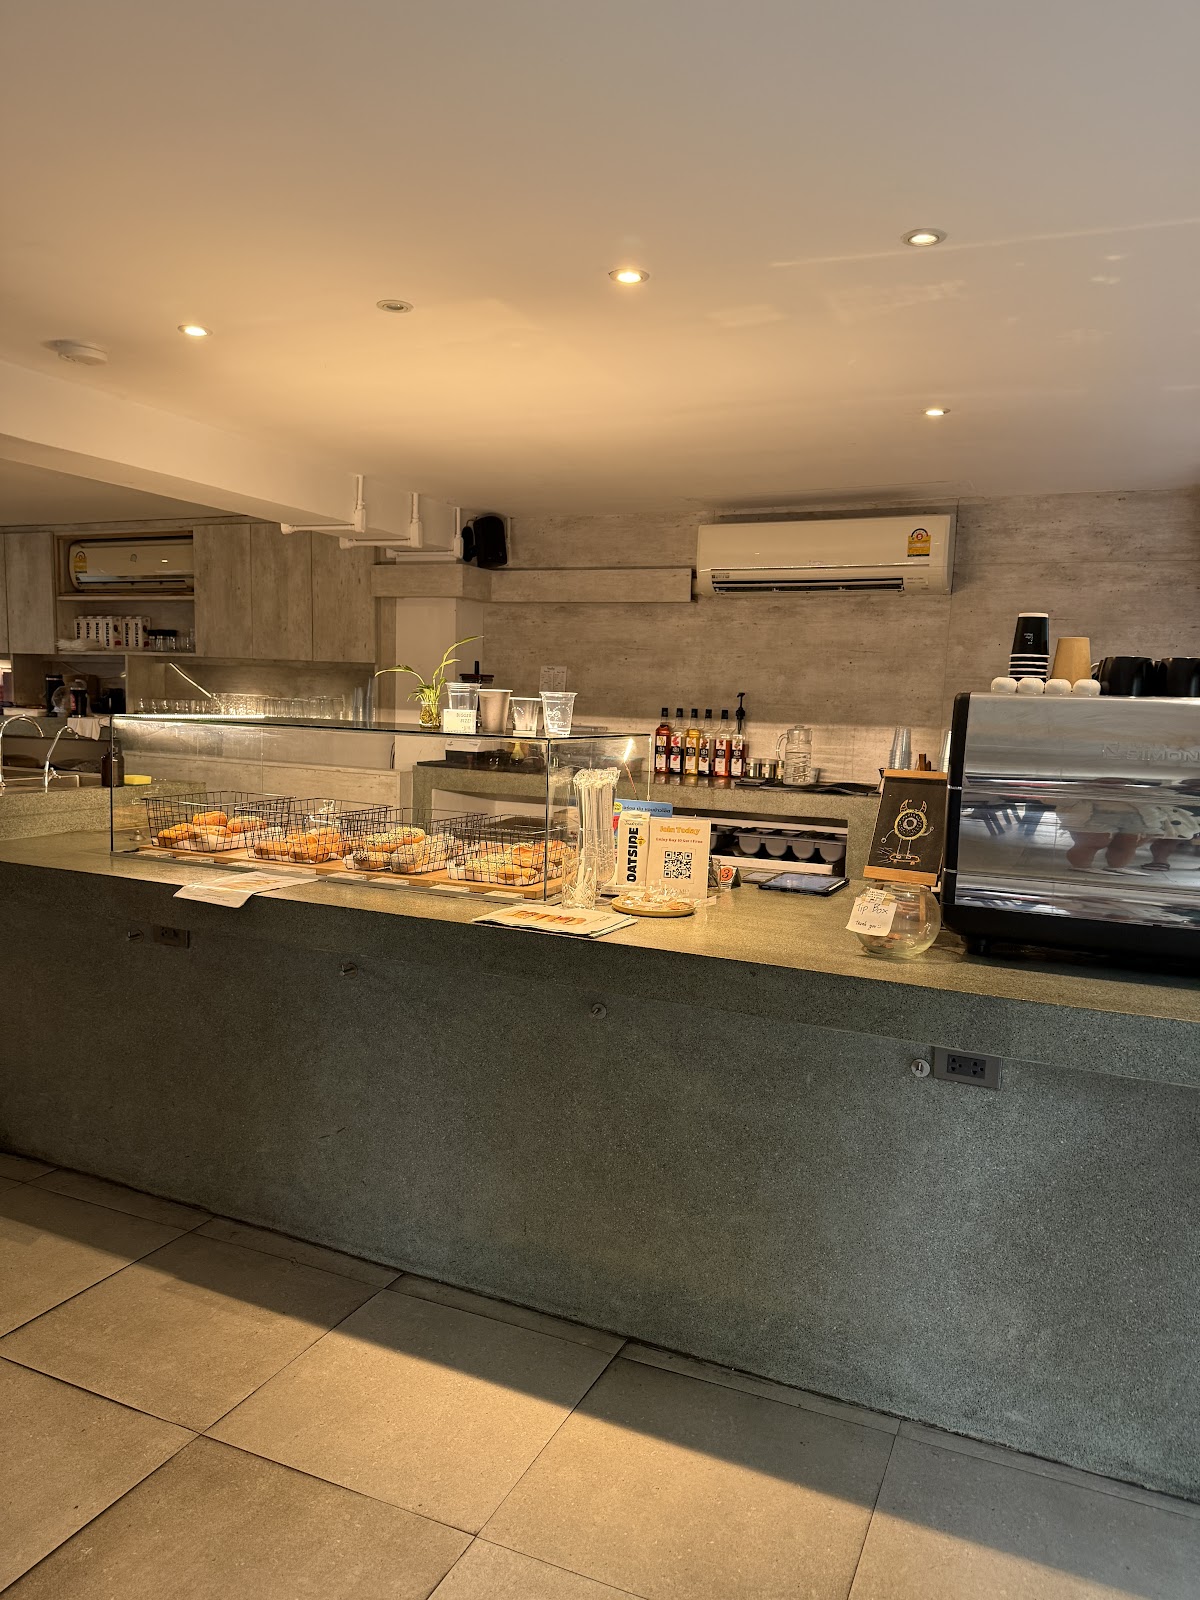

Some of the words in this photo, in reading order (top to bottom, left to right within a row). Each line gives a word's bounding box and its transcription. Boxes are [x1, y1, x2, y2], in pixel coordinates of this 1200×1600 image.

[676, 826, 701, 836] Today
[626, 827, 639, 883] OATSIDE
[721, 868, 730, 879] 3
[856, 901, 869, 916] Tip
[872, 903, 888, 914] Box
